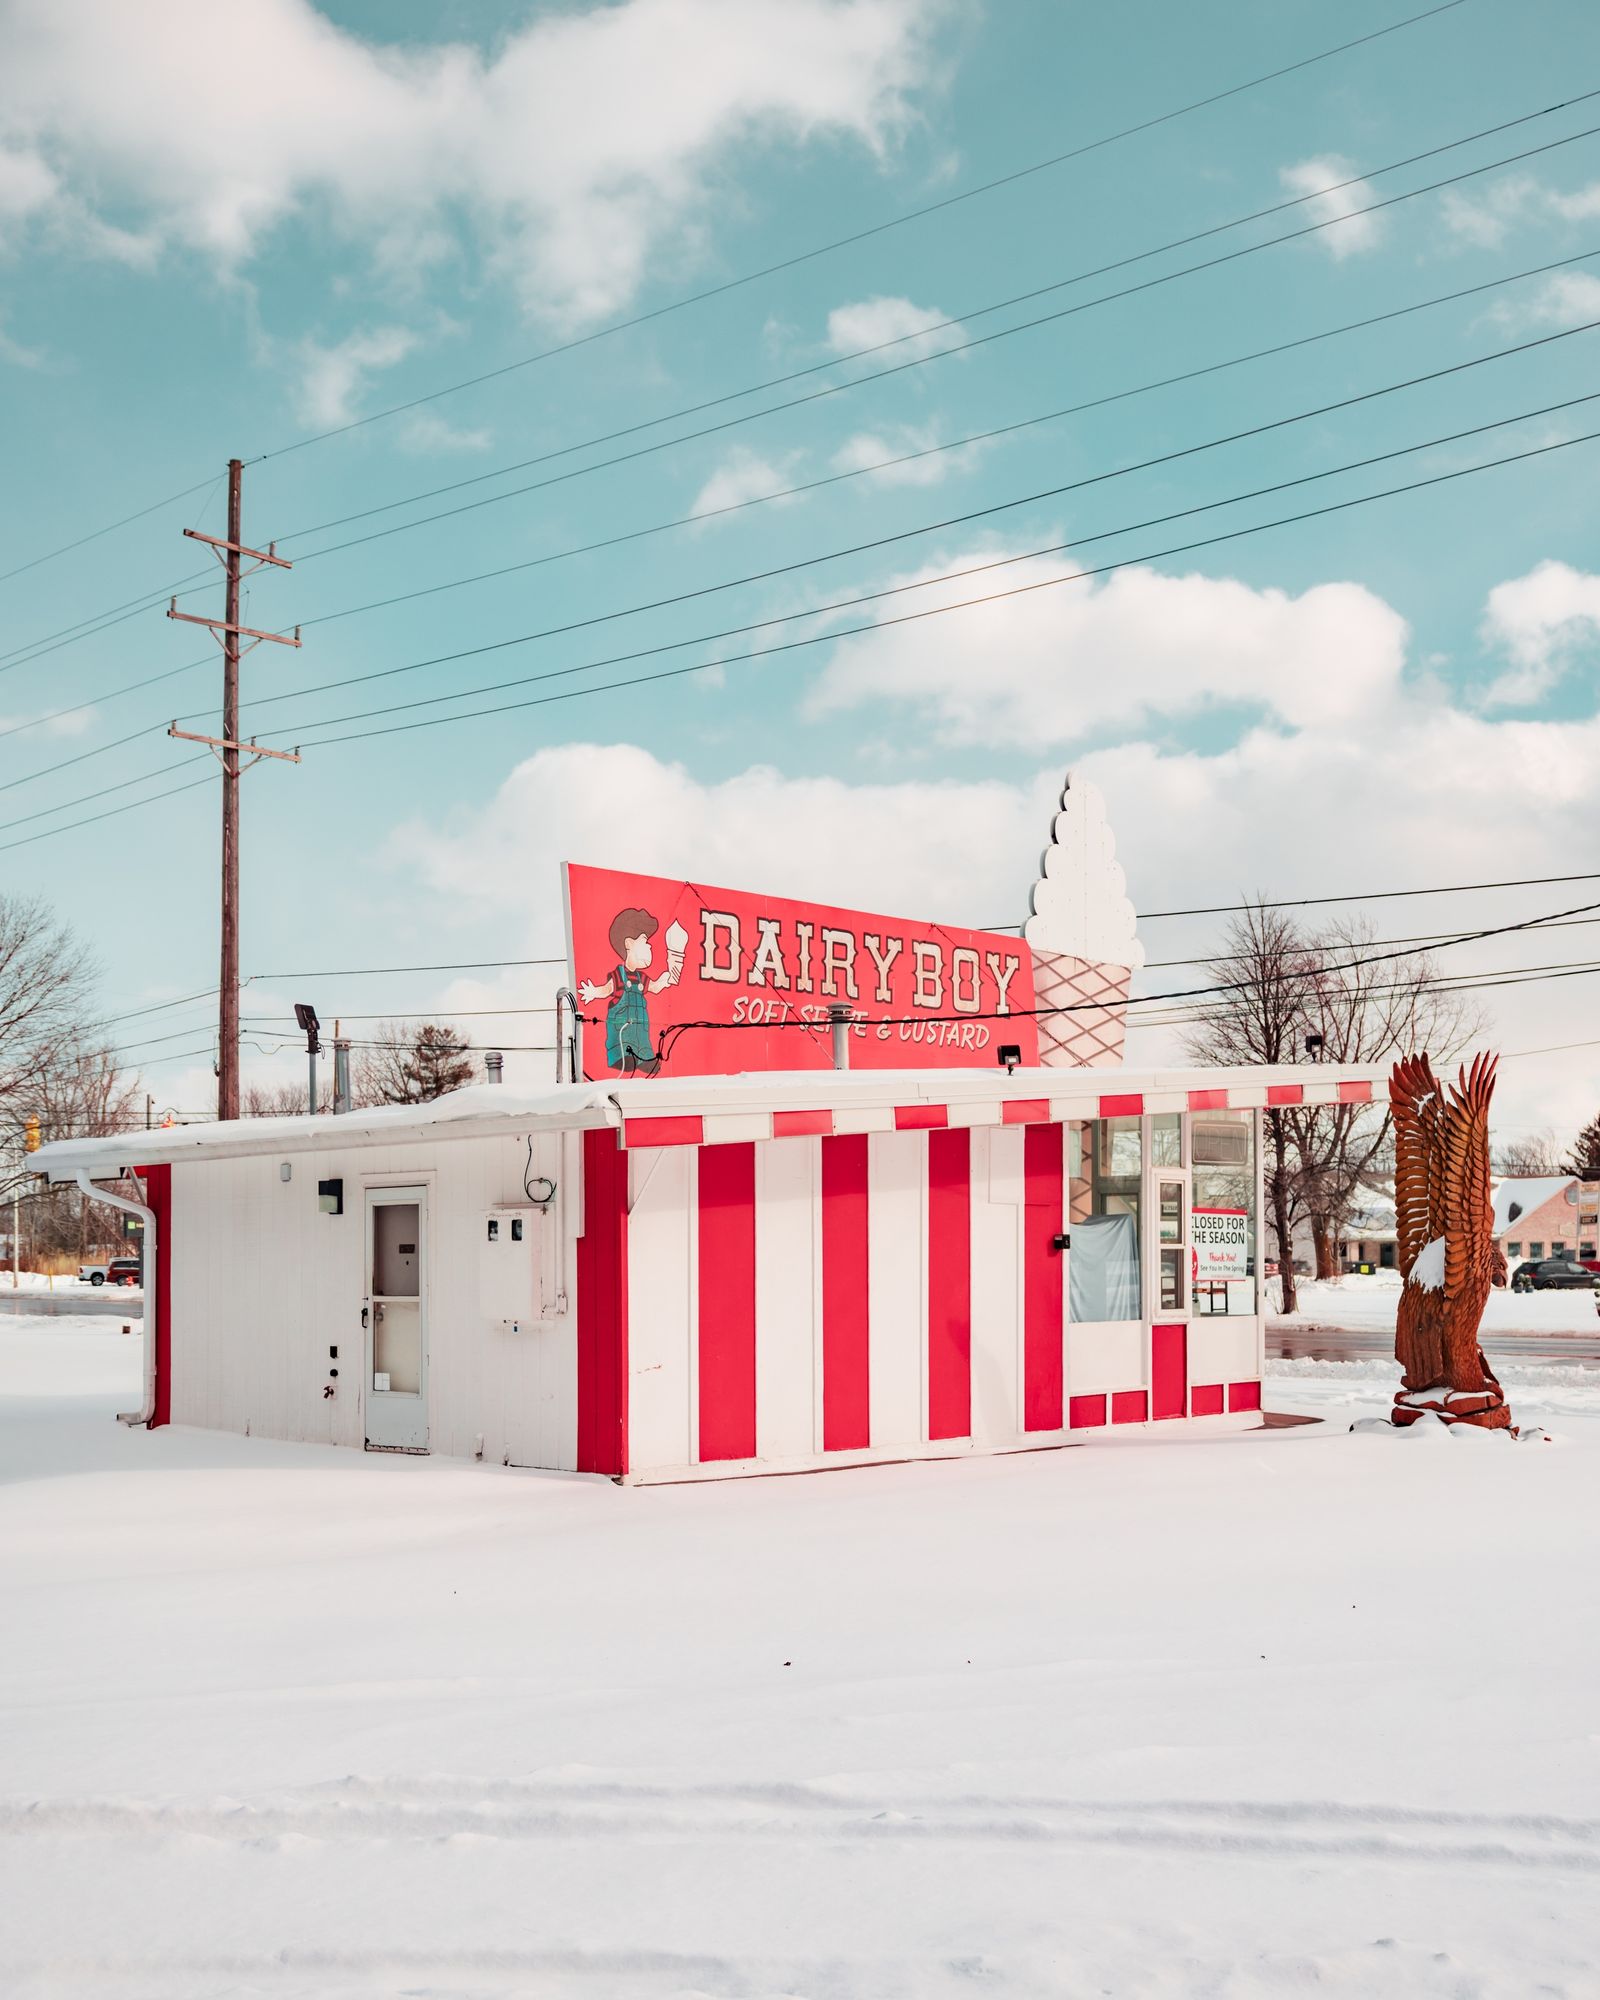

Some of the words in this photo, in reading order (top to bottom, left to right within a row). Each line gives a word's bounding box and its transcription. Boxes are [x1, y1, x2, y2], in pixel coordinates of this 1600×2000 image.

[699, 908, 904, 1004] DAIRY
[912, 939, 1020, 1019] BOY
[732, 996, 794, 1029] SOFT
[876, 1015, 892, 1040] &
[899, 1015, 991, 1052] CUSTARD
[1195, 1127, 1244, 1160] OPEN
[1192, 1216, 1224, 1230] LOSED
[1226, 1216, 1245, 1230] FOR
[1209, 1231, 1245, 1244] SEASON
[1209, 1252, 1225, 1262] Thank
